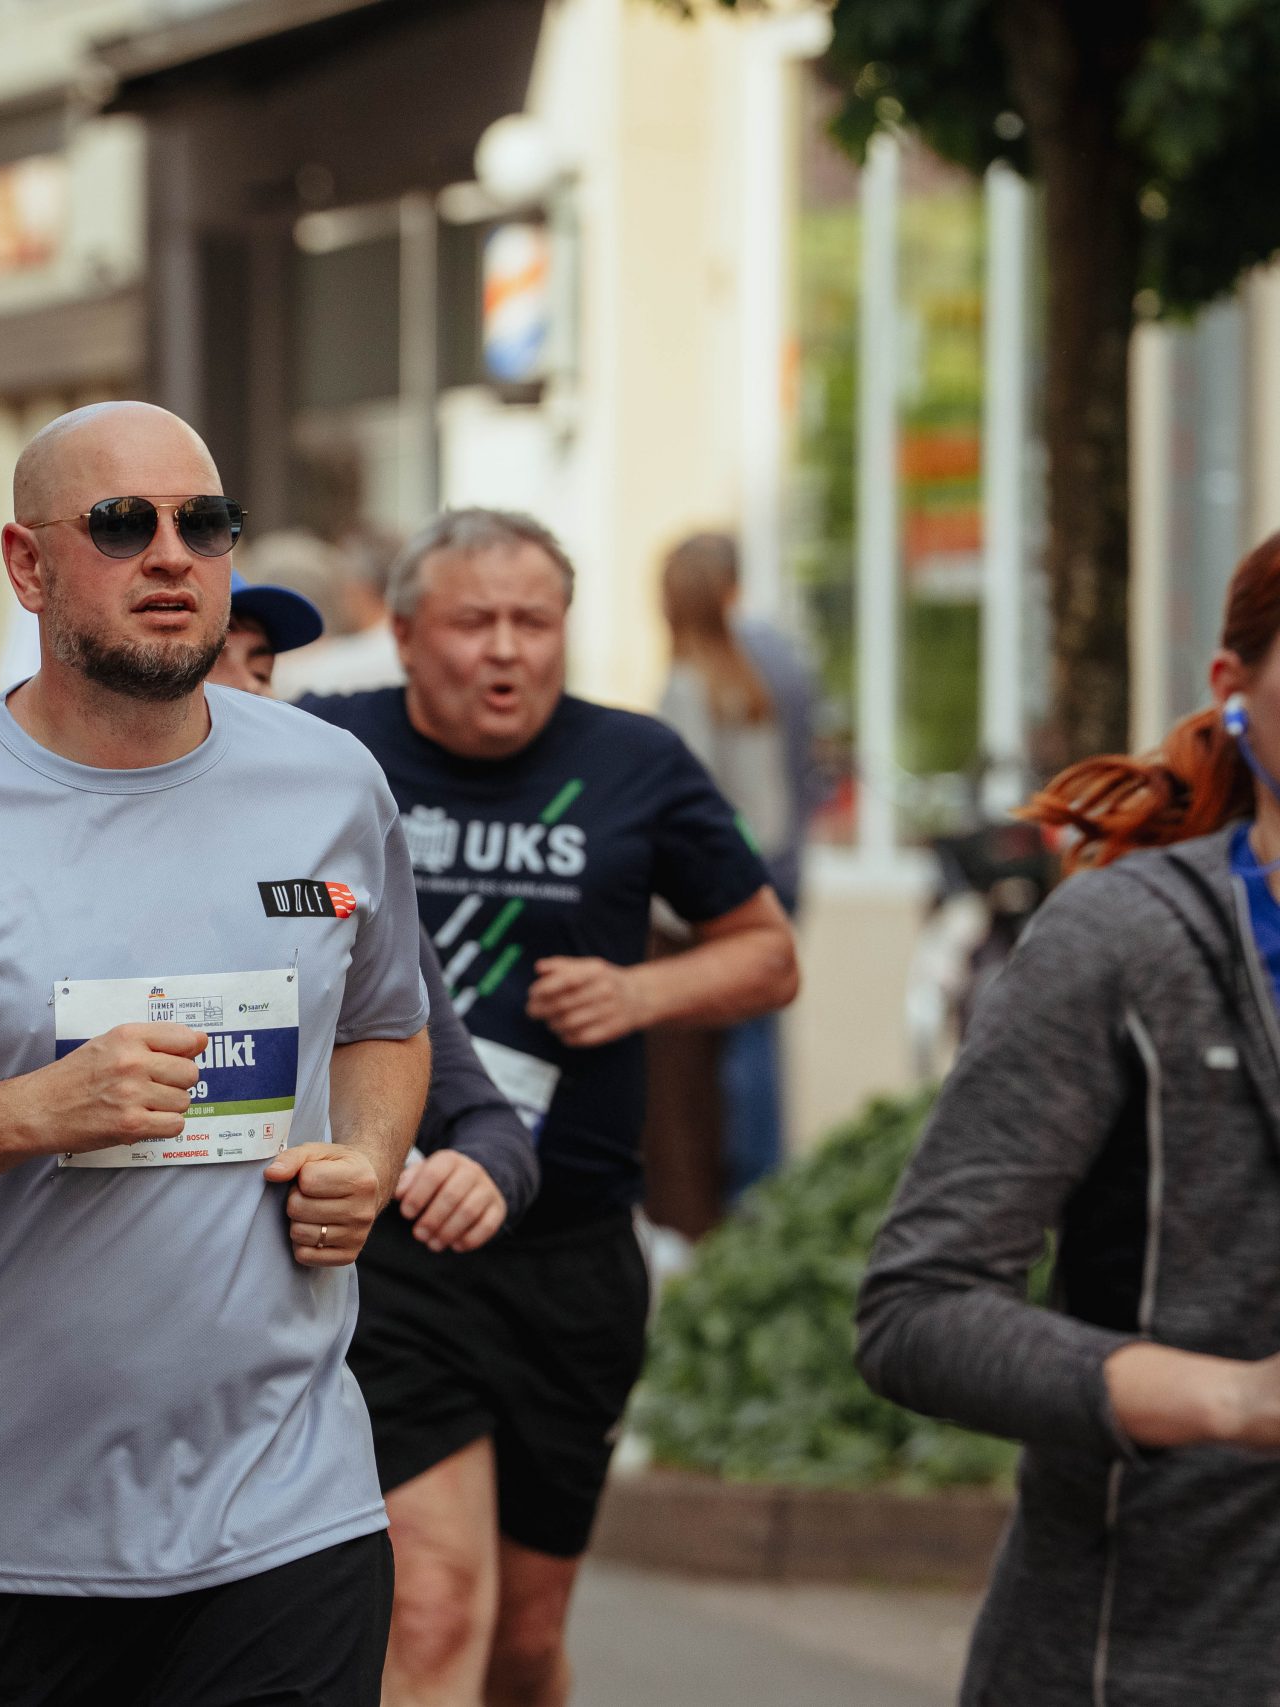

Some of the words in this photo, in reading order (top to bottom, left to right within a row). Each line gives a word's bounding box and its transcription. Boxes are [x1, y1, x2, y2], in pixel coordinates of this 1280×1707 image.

[464, 819, 587, 877] UKS
[271, 884, 324, 912] WOLF
[151, 1010, 174, 1021] LAUF
[195, 1034, 256, 1070] dikt
[186, 1133, 210, 1141] BOSCH
[162, 1150, 209, 1159] WOCHENSPIEGEL
